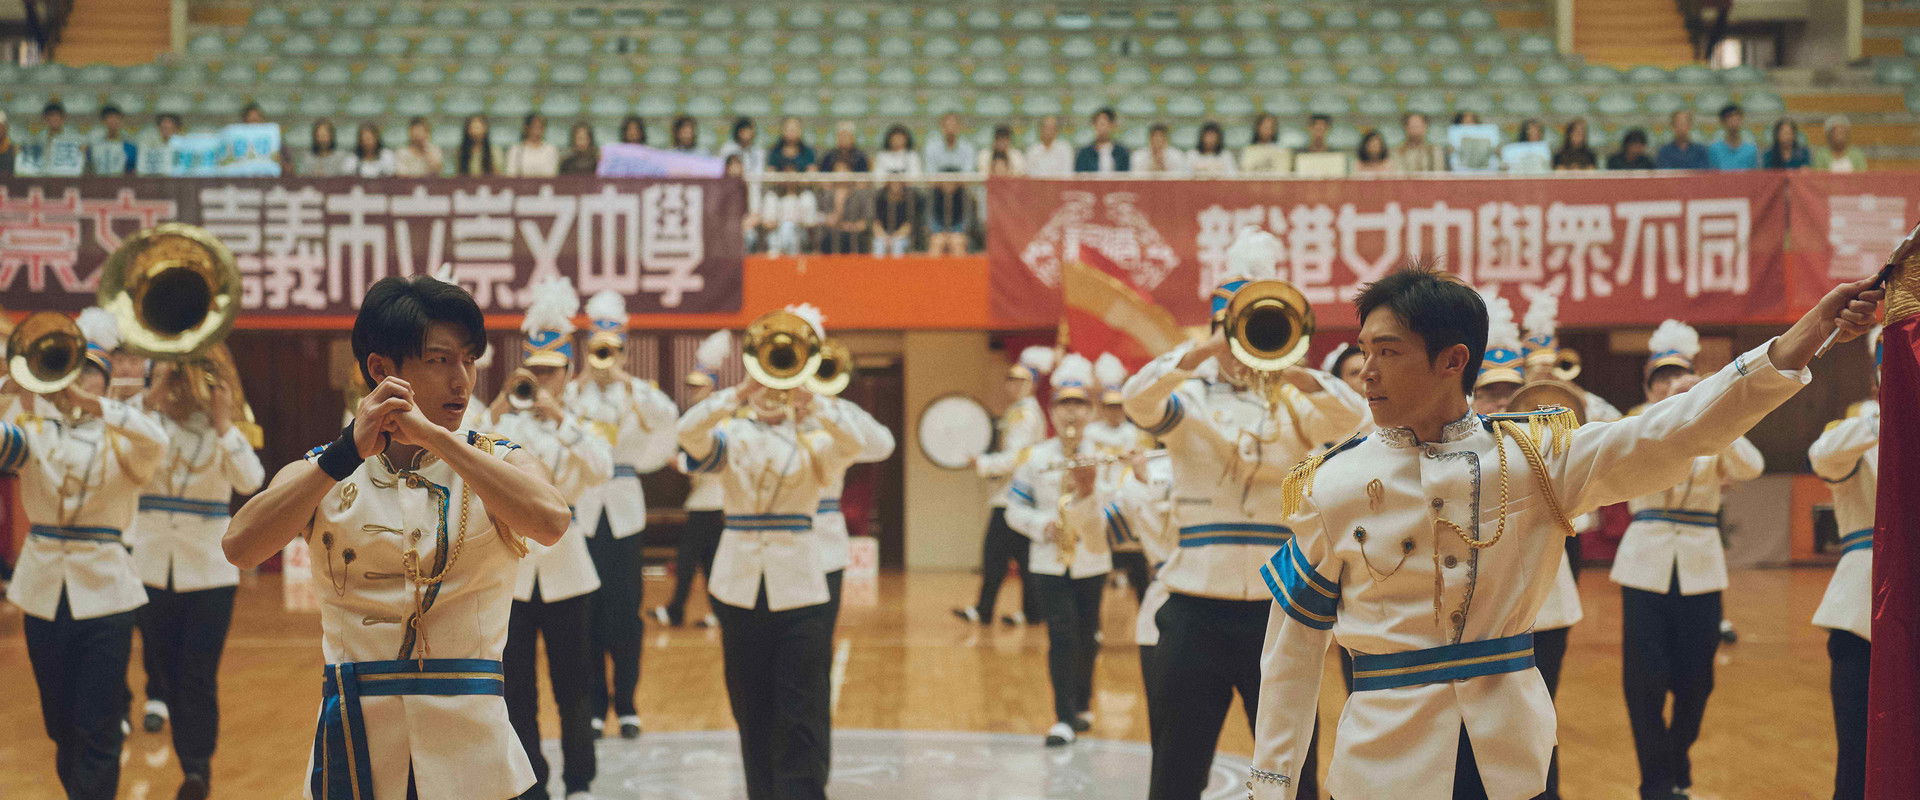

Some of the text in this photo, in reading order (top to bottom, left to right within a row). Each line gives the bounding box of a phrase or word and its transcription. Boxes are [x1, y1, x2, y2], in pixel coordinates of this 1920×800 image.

[199, 186, 705, 309] 嘉義市立崇文中學
[1196, 199, 1752, 303] 新港女中與眾不同
